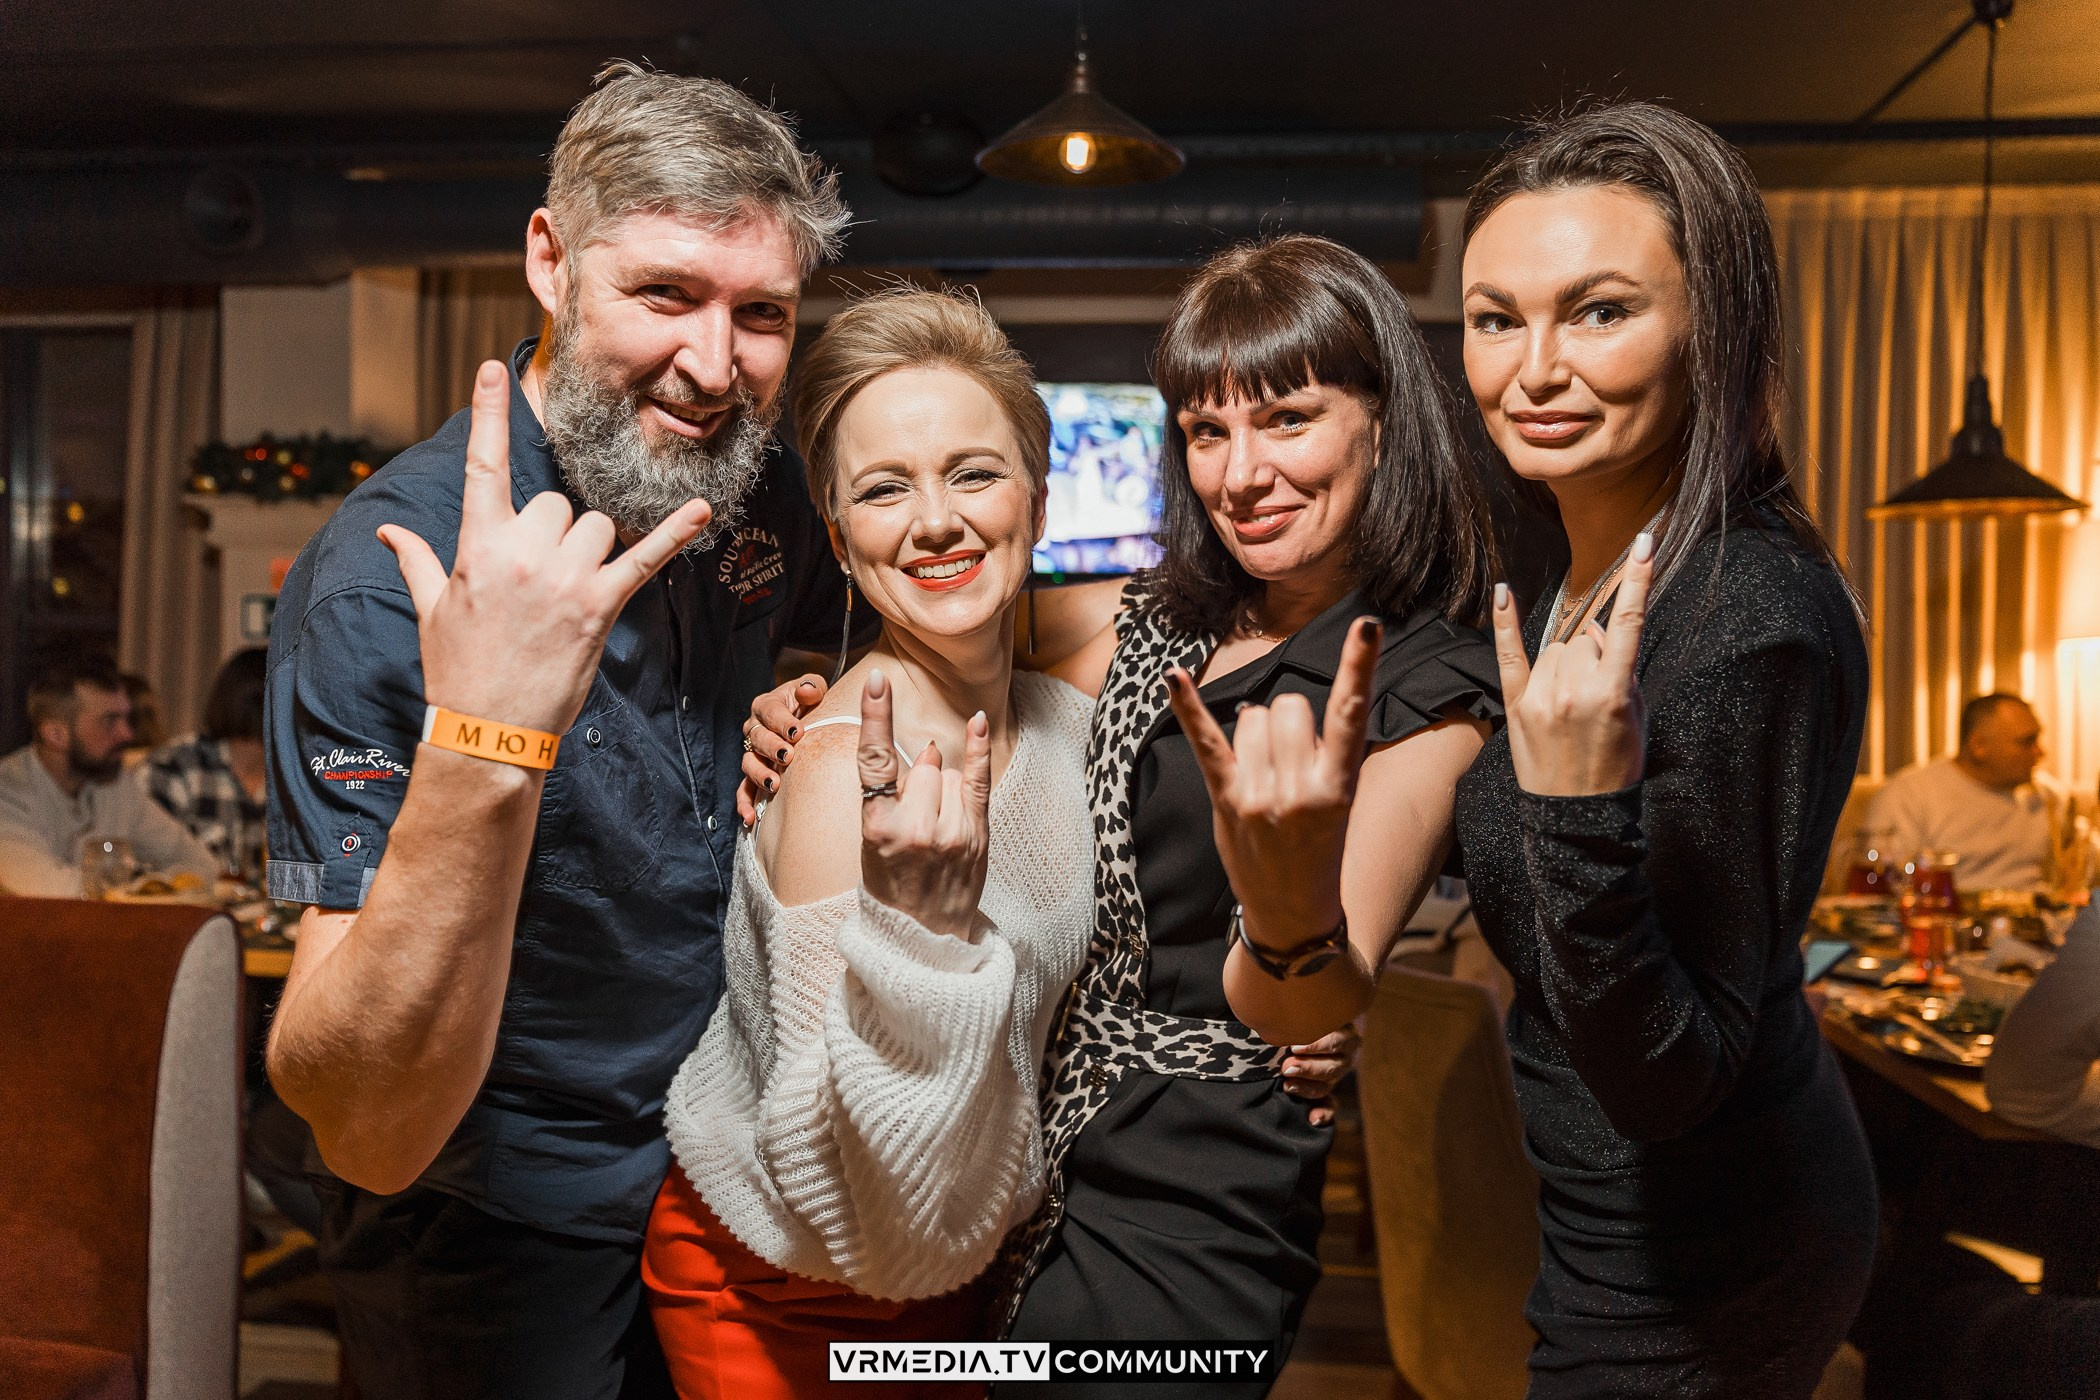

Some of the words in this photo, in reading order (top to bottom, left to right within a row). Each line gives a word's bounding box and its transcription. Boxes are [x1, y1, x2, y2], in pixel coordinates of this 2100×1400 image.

[751, 561, 785, 587] SPIRIT
[329, 748, 366, 767] Clair
[364, 748, 411, 777] River
[323, 769, 393, 780] CHAMPIONSHIP
[345, 780, 365, 790] 1922
